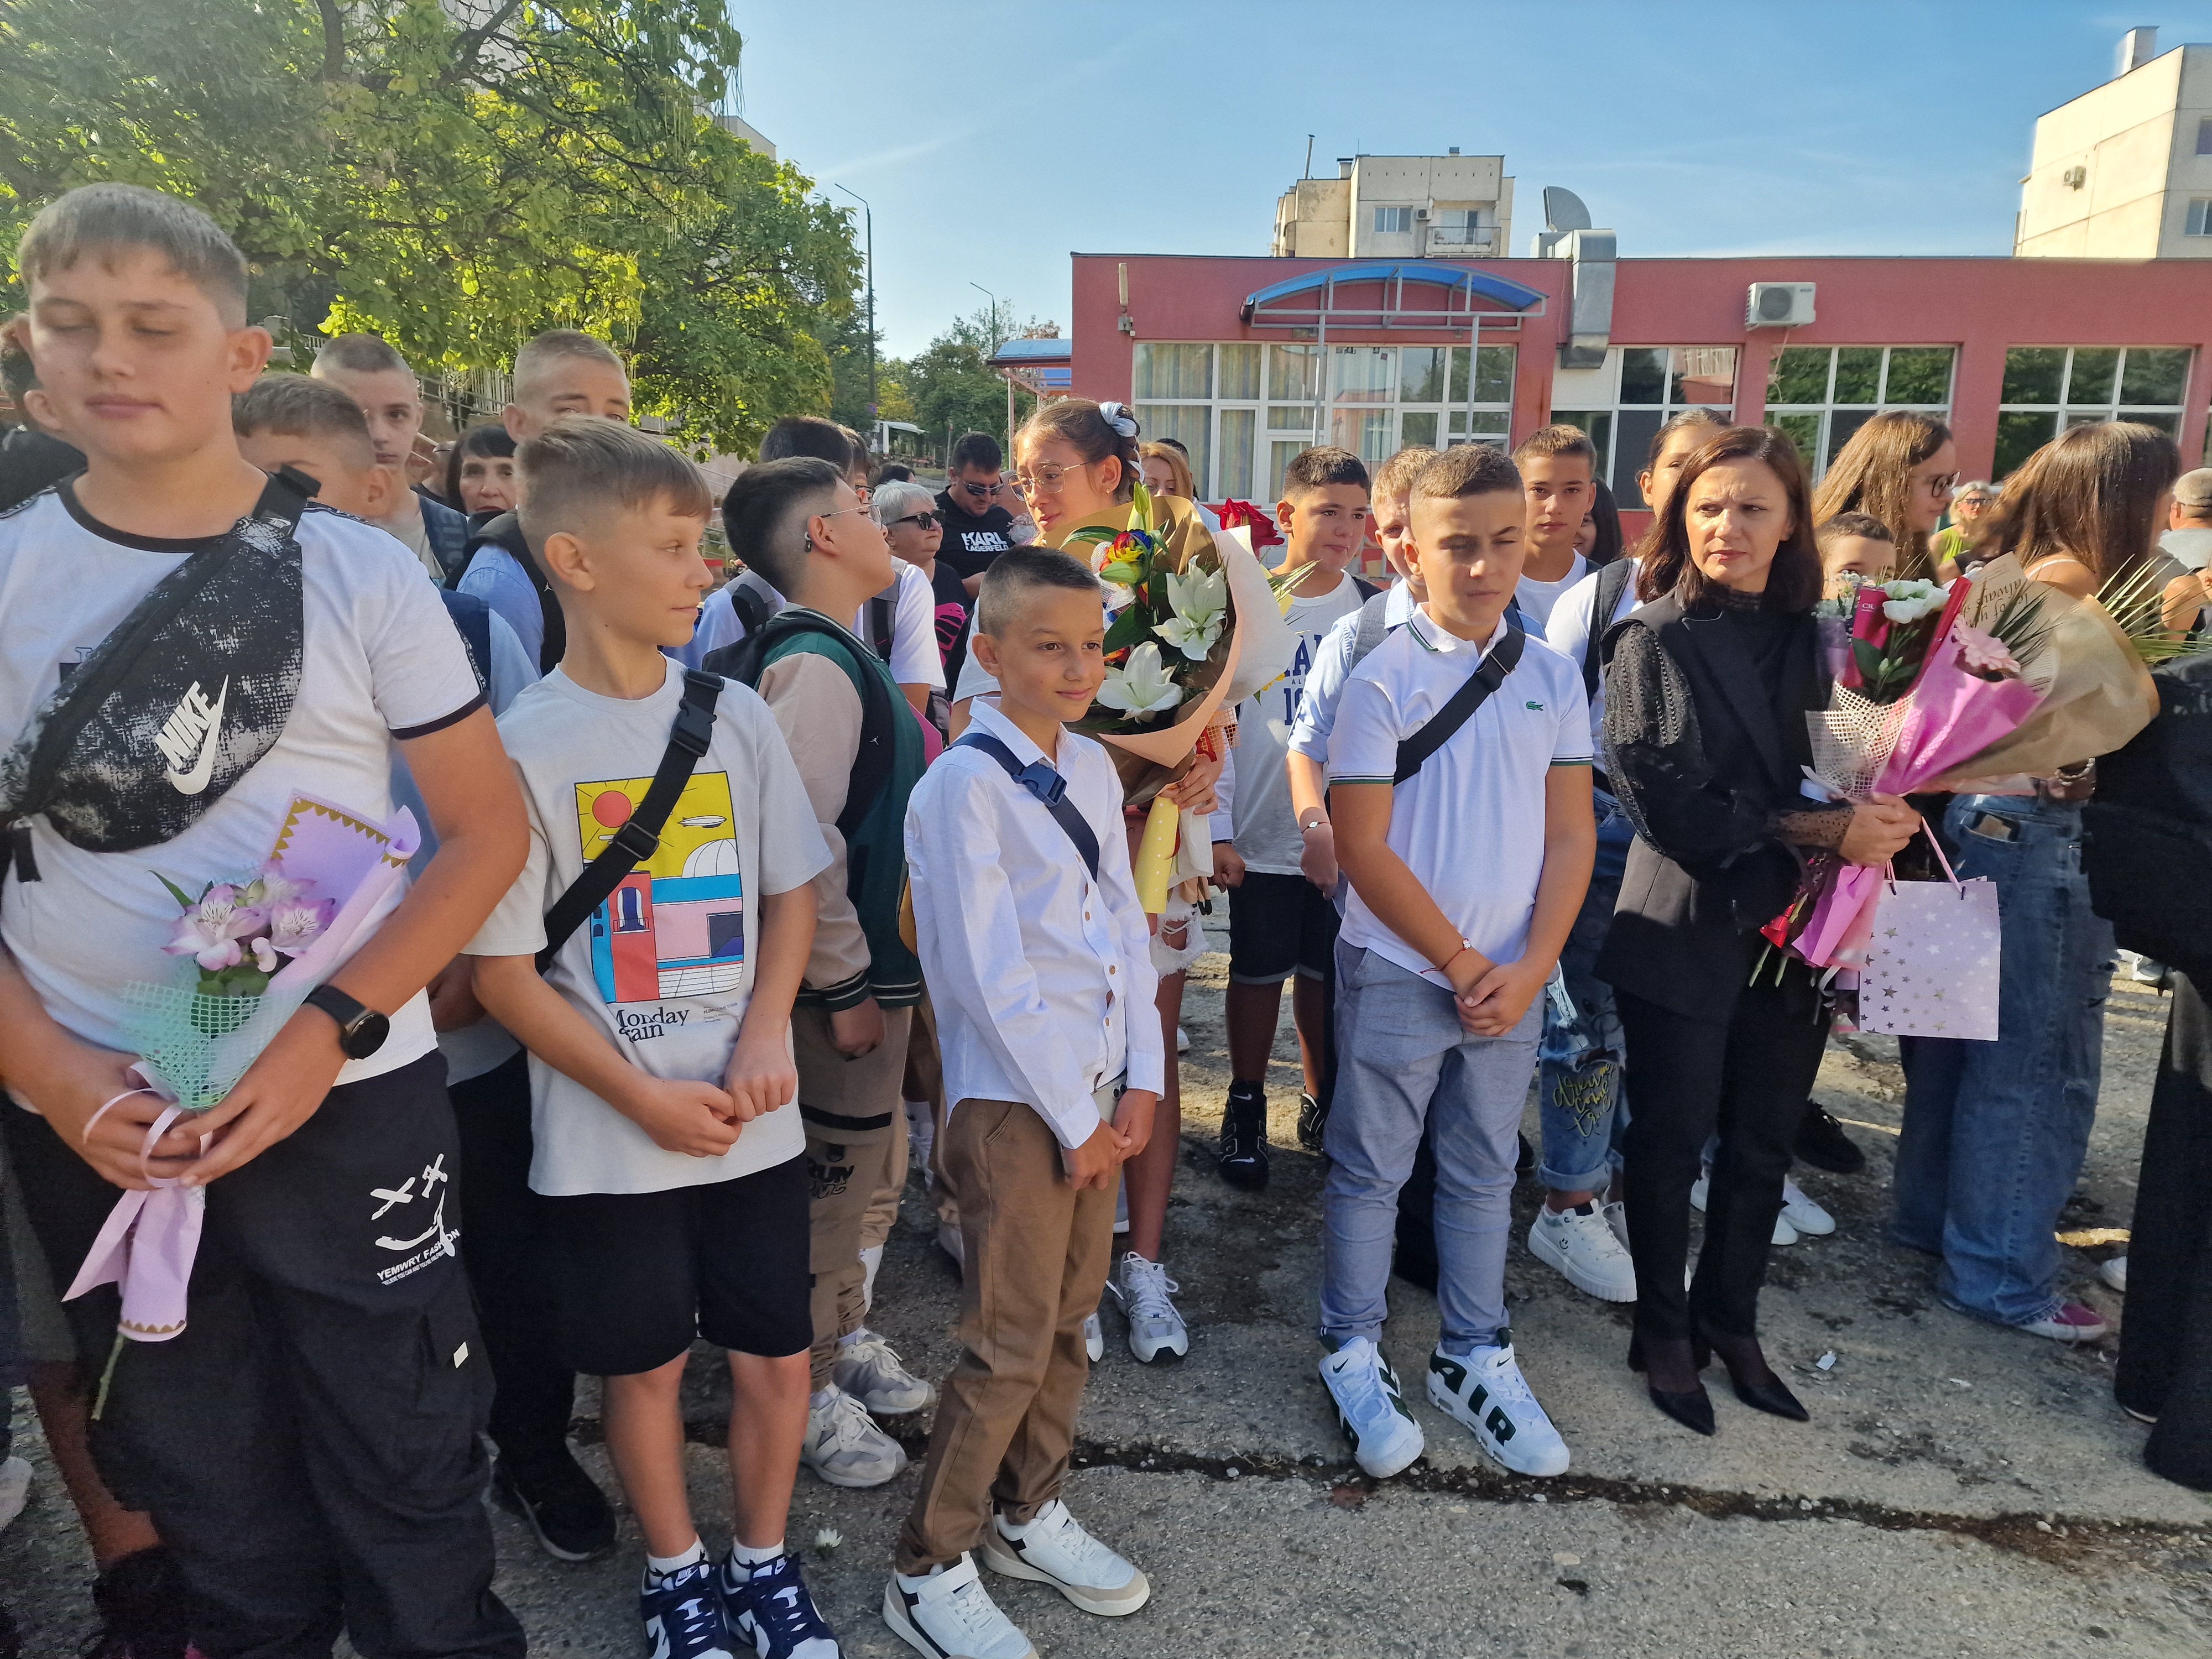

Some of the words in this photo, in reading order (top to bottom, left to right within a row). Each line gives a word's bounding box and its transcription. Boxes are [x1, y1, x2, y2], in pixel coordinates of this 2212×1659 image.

[961, 531, 1007, 546] KARL
[154, 680, 217, 770] NIKE
[377, 1253, 421, 1280] YEMWRY
[423, 1228, 461, 1260] FASHON
[1430, 1348, 1516, 1447] AIR
